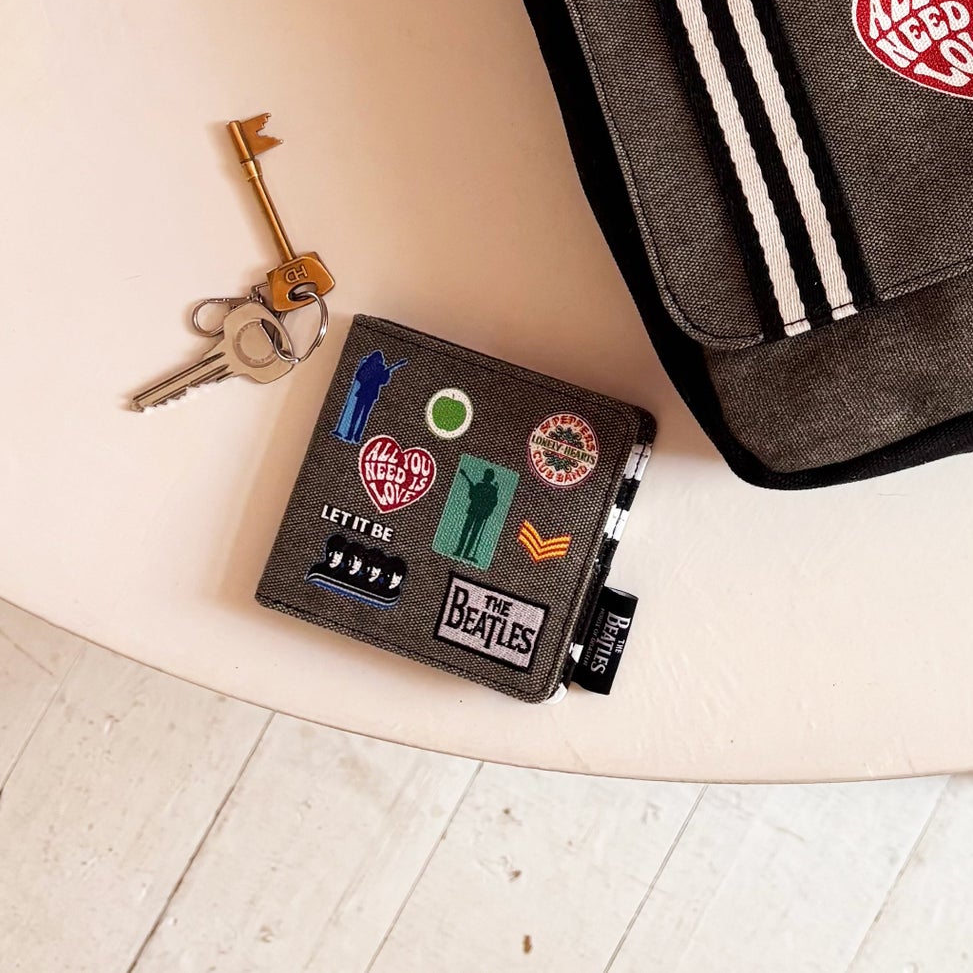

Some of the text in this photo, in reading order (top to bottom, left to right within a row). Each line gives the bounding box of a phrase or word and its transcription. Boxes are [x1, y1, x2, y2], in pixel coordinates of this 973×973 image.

[875, 0, 970, 68] NEED
[531, 434, 597, 465] LONELY HEARTS
[551, 414, 596, 452] PEPPERS
[365, 441, 432, 477] ALL YOU
[532, 450, 588, 483] CLUB BAND
[364, 462, 429, 492] NEED IS
[369, 481, 417, 506] LOVE
[321, 504, 394, 543] LET IT BE
[444, 585, 537, 655] BEATLES
[484, 594, 514, 618] THE
[590, 610, 632, 675] BEATLES
[614, 638, 626, 654] THE
